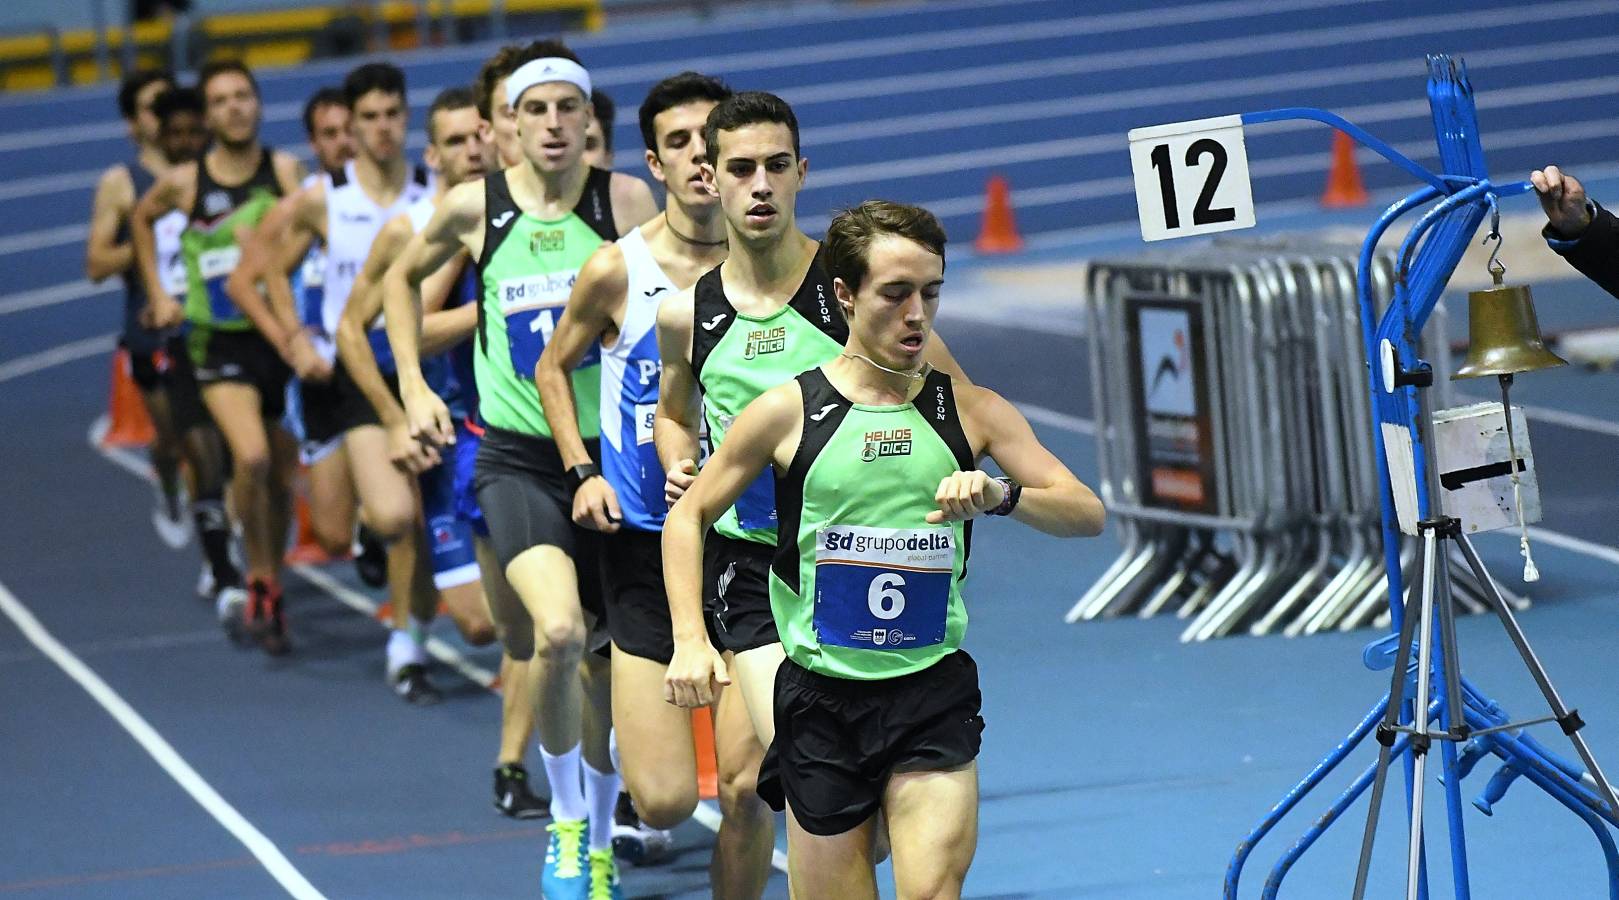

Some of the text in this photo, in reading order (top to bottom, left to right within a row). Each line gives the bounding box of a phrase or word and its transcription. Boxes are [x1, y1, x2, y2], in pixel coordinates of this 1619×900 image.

[1151, 138, 1236, 229] 12
[505, 275, 576, 300] gd grupod
[816, 284, 831, 323] CAYON
[936, 386, 946, 420] CAYON
[825, 531, 950, 554] gd grupodelta
[867, 572, 906, 620] 6
